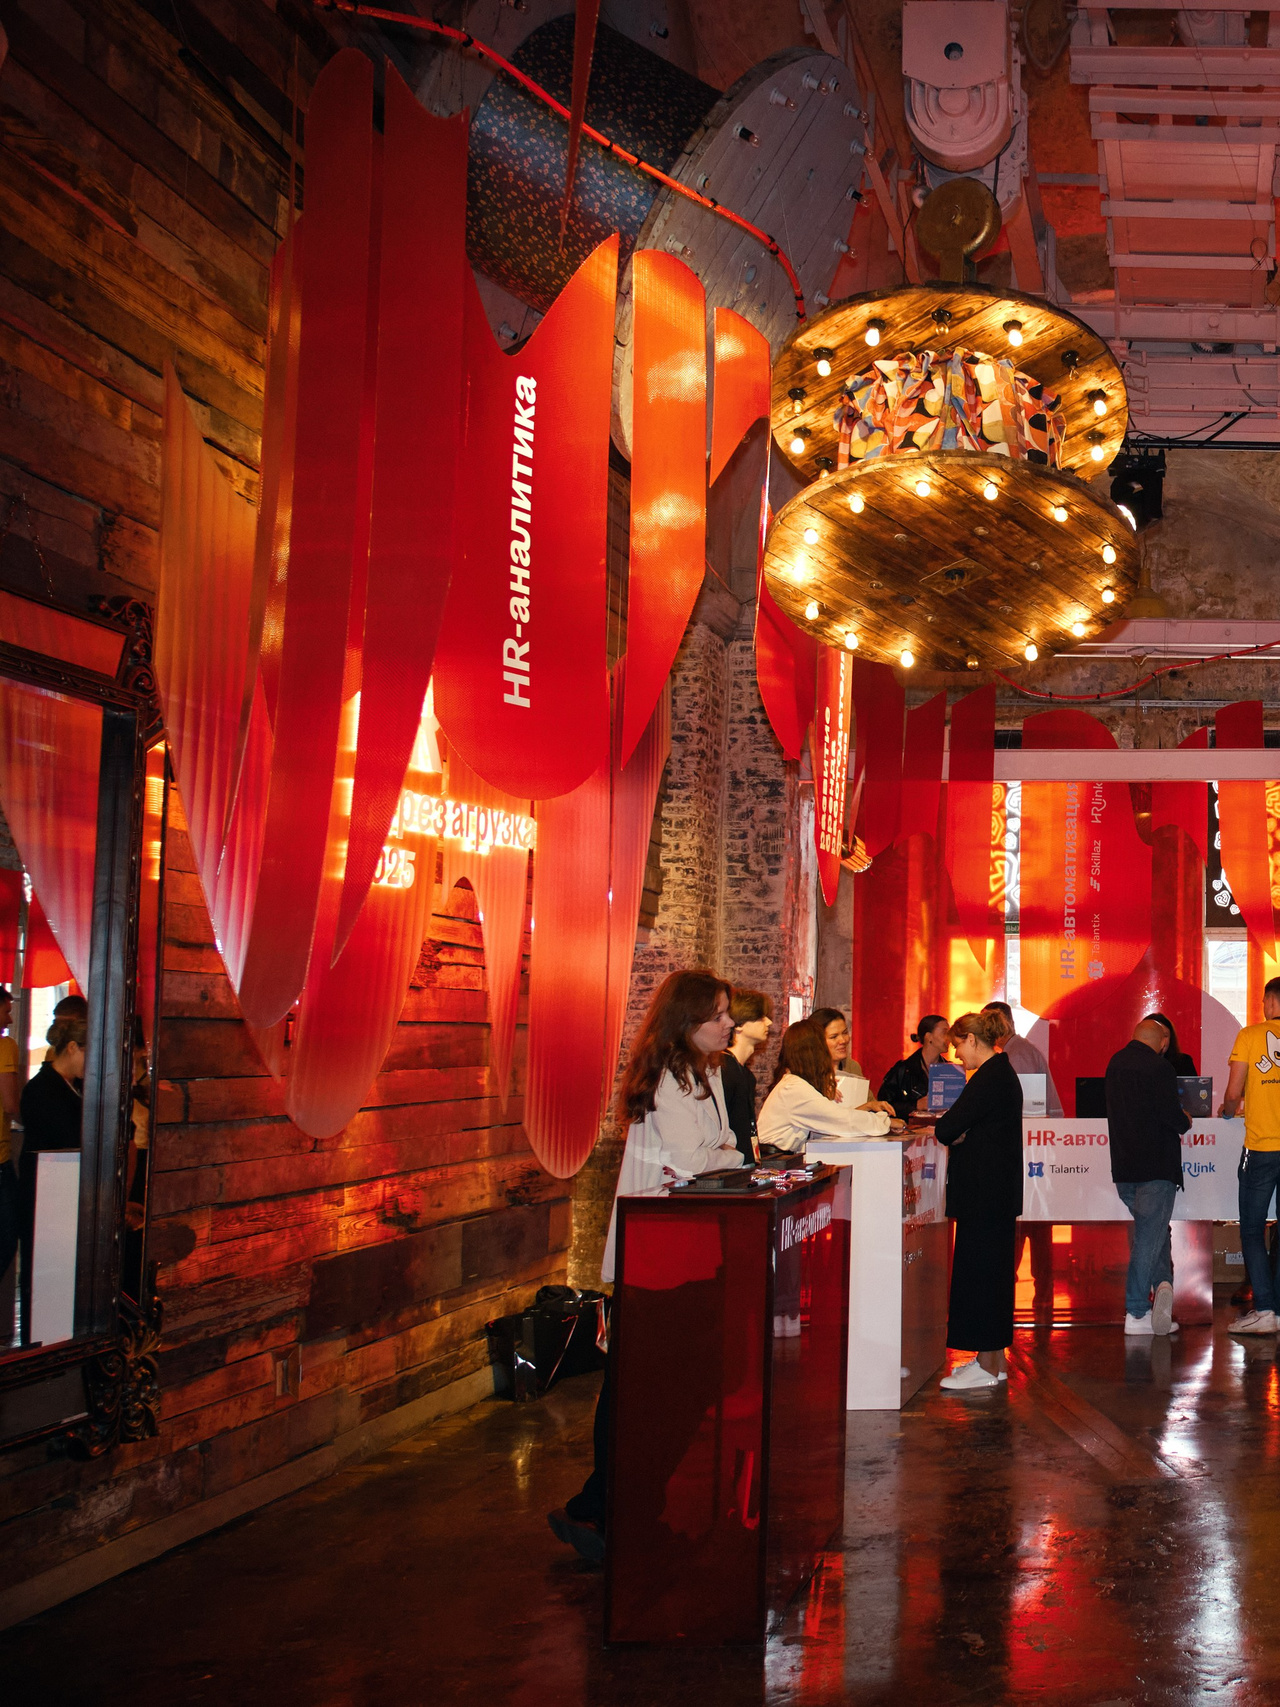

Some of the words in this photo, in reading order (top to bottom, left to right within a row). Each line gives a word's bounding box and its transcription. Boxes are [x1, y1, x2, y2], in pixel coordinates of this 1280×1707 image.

[503, 374, 537, 709] HR-аналитика
[397, 787, 537, 852] резагрузка
[373, 847, 416, 899] 025
[1060, 781, 1080, 979] HR-автоматизация
[1091, 839, 1101, 876] Skillaz
[1091, 913, 1100, 955] Talantix
[1027, 1130, 1216, 1147] HR-автоция
[1049, 1164, 1090, 1174] Talantix
[1182, 1161, 1216, 1178] Rlink
